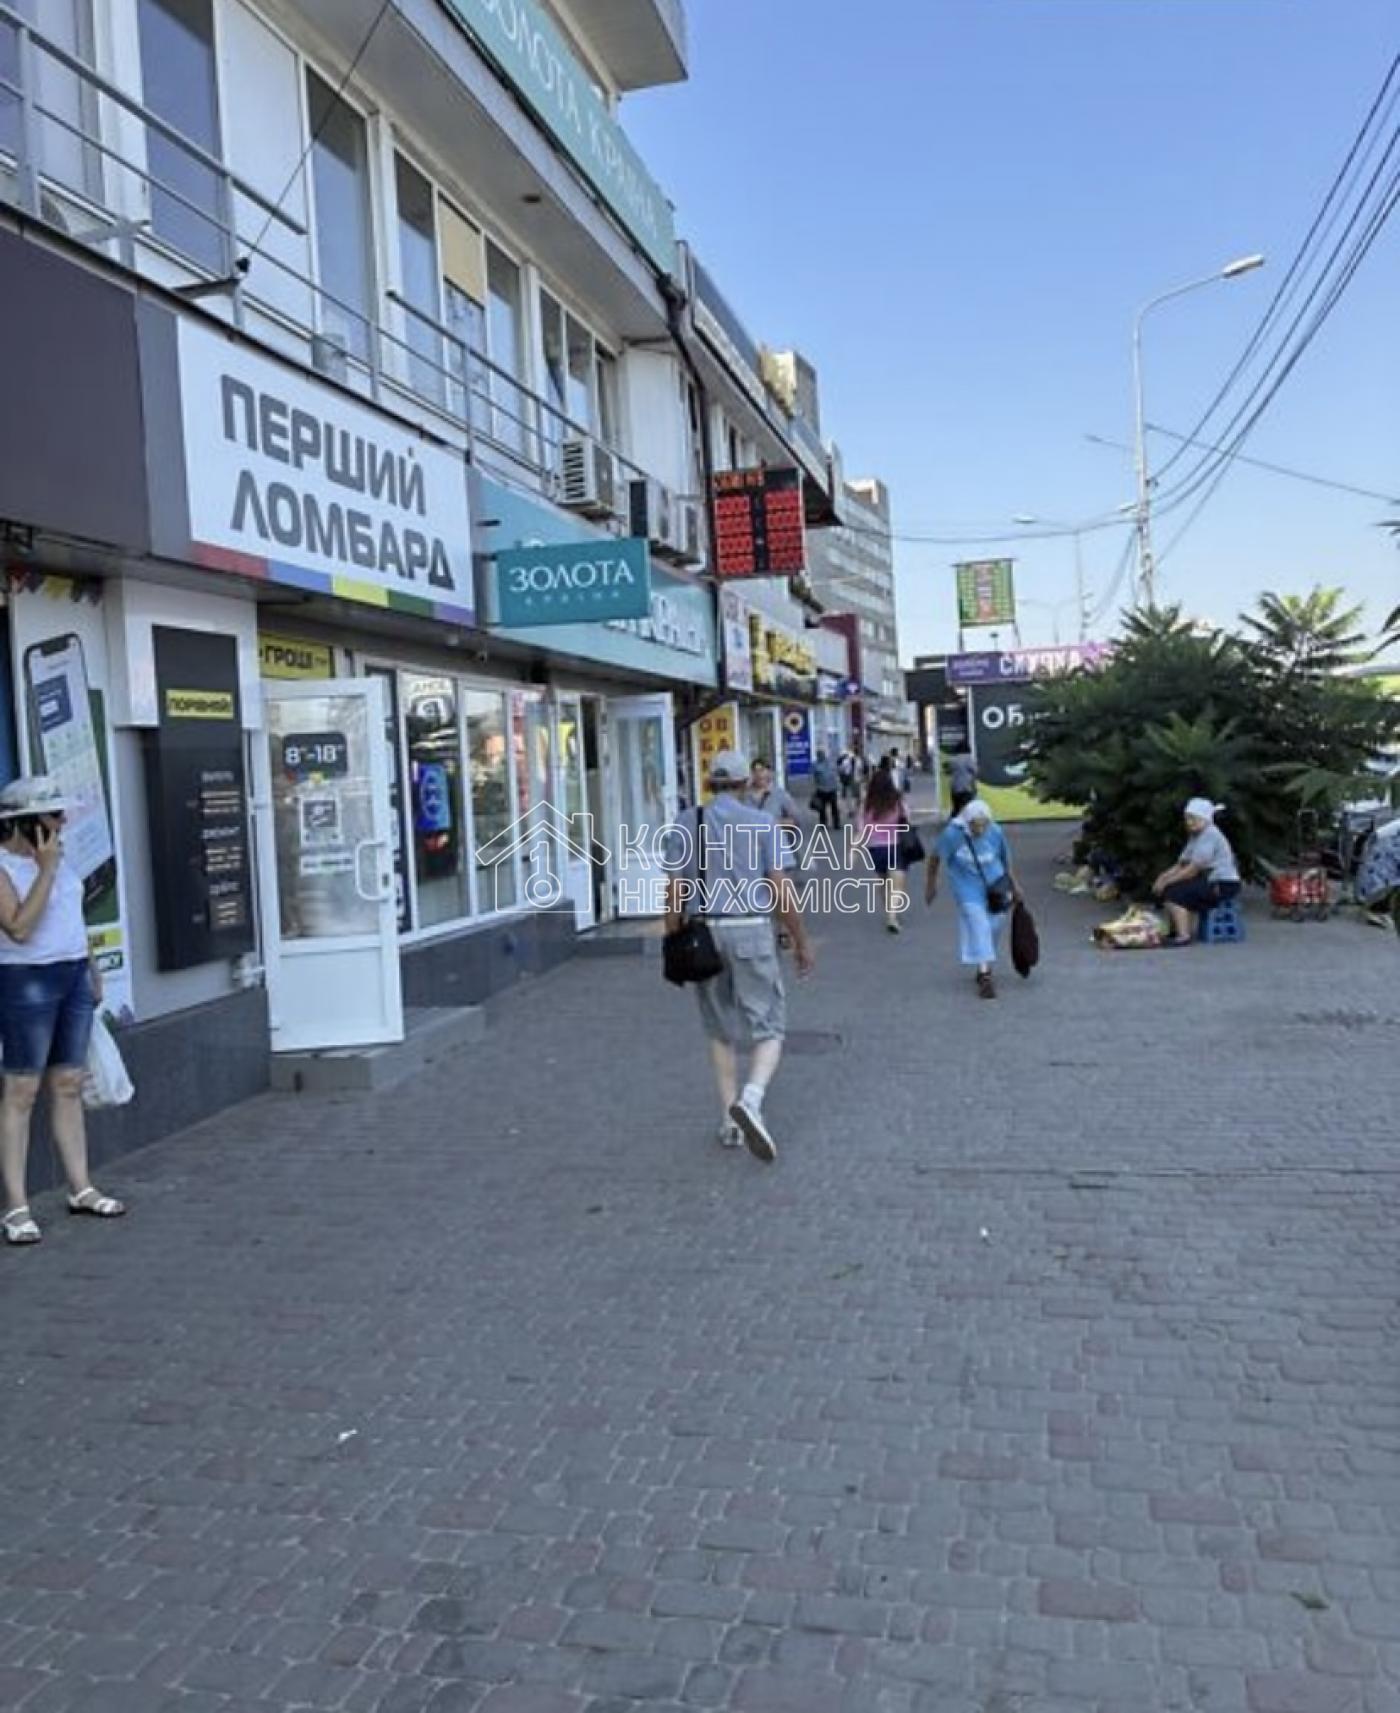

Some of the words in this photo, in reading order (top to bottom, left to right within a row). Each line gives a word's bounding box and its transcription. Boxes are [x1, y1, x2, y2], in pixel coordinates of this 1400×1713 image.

[221, 374, 426, 516] ПЕРШИЙ
[231, 470, 455, 591] ЛОМБАРД
[509, 559, 634, 592] ЗОЛОТА
